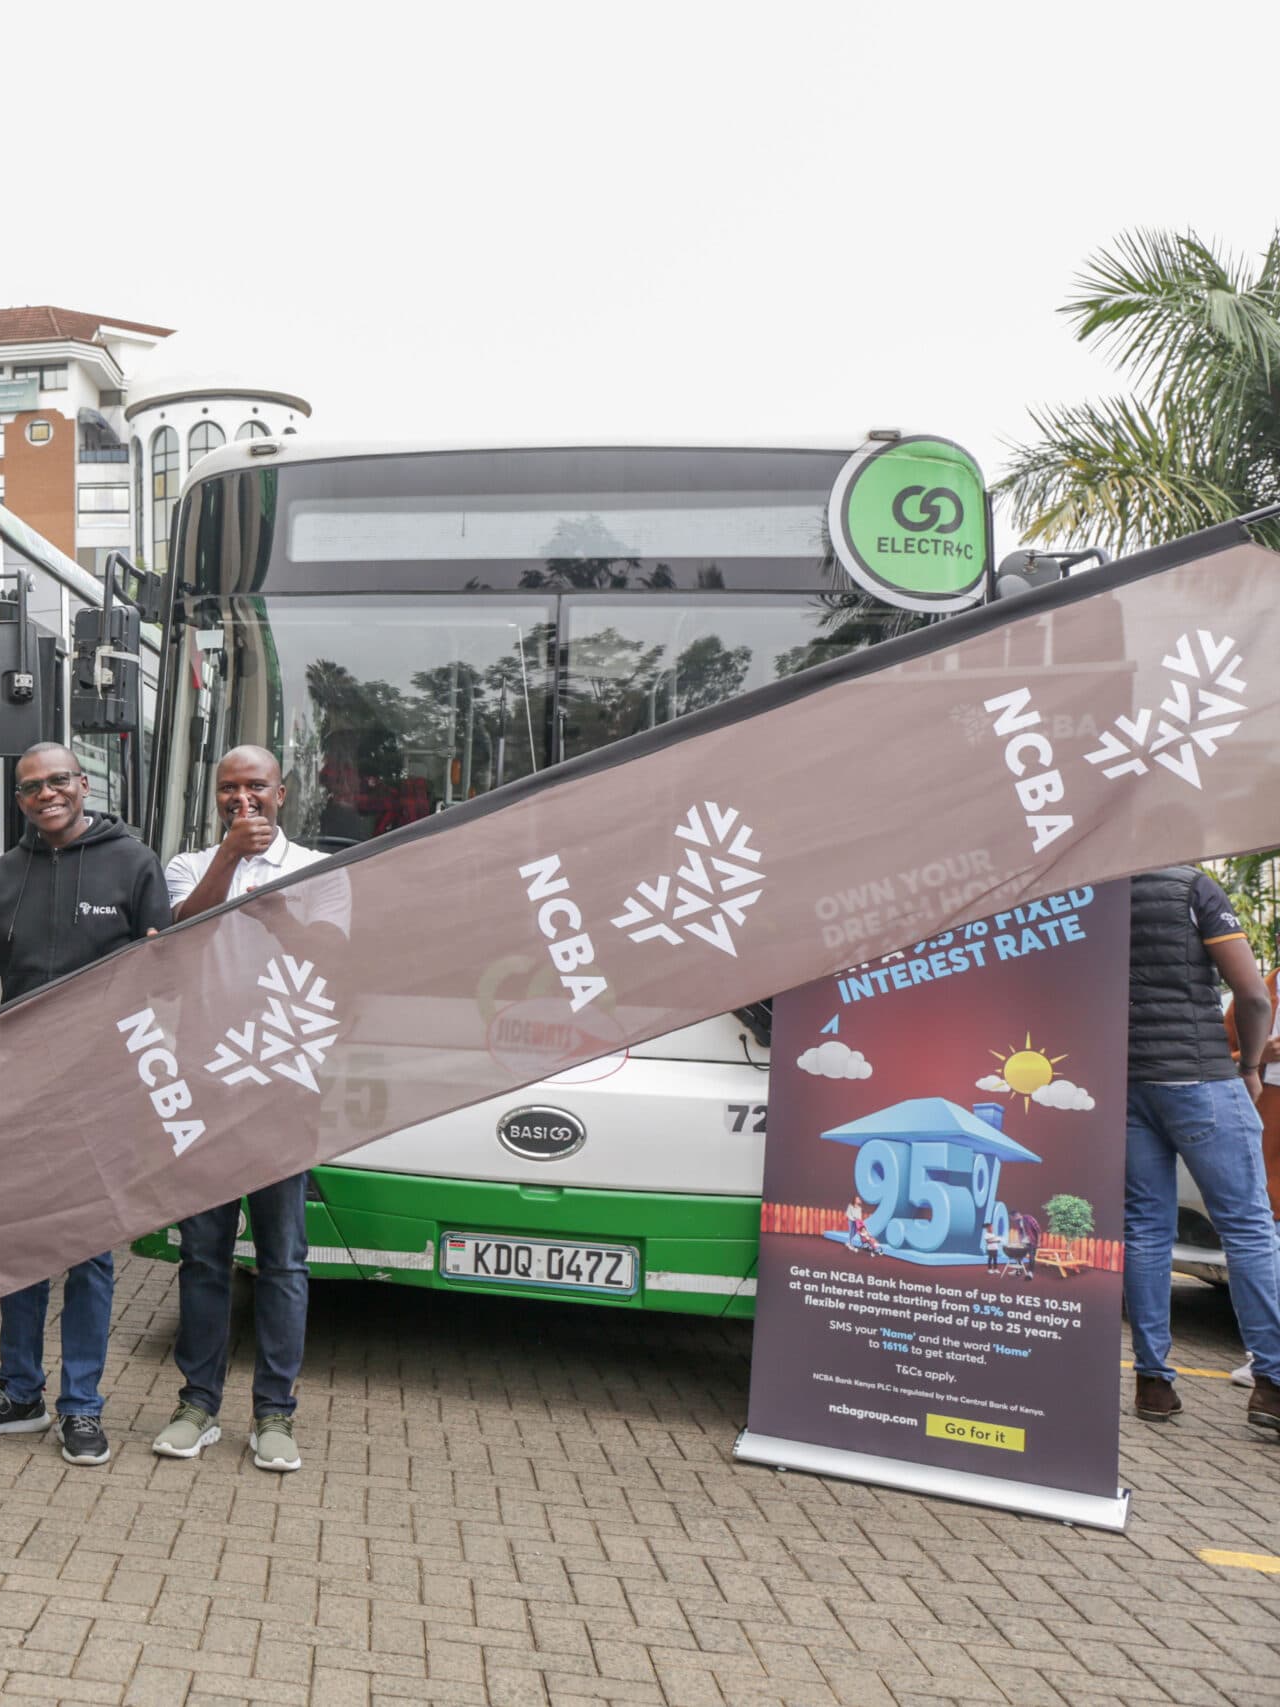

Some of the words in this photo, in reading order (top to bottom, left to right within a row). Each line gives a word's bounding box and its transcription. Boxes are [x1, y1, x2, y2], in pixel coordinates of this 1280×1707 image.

[983, 687, 1074, 854] NCBA
[815, 872, 896, 920] OWN
[898, 849, 994, 896] YOUR
[92, 905, 118, 915] NCBA
[519, 854, 609, 1013] NCBA
[837, 940, 987, 1004] INTEREST
[993, 914, 1087, 961] RATE
[115, 1007, 206, 1157] NCBA
[473, 1242, 532, 1278] KDQ
[546, 1247, 623, 1285] 047Z
[789, 1280, 802, 1290] at
[804, 1283, 818, 1292] an
[821, 1284, 864, 1299] Interest
[867, 1291, 890, 1302] rate
[893, 1294, 938, 1310] starting
[941, 1300, 970, 1312] from
[972, 1304, 1004, 1318] 9.5%
[1007, 1310, 1032, 1320] and
[1034, 1314, 1069, 1328] enjoy
[1072, 1320, 1081, 1328] a
[790, 1266, 810, 1278] Get
[813, 1270, 828, 1280] an
[830, 1270, 864, 1284] NCBA
[867, 1276, 896, 1288] Bank
[899, 1279, 932, 1293] home
[936, 1284, 962, 1298] loan
[965, 1289, 978, 1299] of
[981, 1292, 997, 1303] up
[1000, 1294, 1013, 1304] to
[1016, 1294, 1040, 1308] KES
[1044, 1299, 1082, 1312] 10.5M
[804, 1295, 846, 1310] flexible
[848, 1302, 912, 1319] repayment
[914, 1311, 952, 1324] period
[956, 1316, 969, 1326] of
[972, 1320, 987, 1331] up
[990, 1321, 1004, 1332] to
[1006, 1322, 1021, 1334] 25
[1024, 1326, 1062, 1340] years.
[829, 1320, 852, 1332] SMS
[855, 1326, 878, 1336] your
[918, 1334, 940, 1344] and
[942, 1336, 960, 1348] the
[962, 1341, 990, 1352] word
[868, 1340, 880, 1349] to
[882, 1341, 908, 1353] 16116
[911, 1345, 922, 1355] to
[924, 1350, 943, 1358] get
[945, 1350, 987, 1364] started.
[896, 1364, 922, 1377] T&Cs
[924, 1370, 957, 1383] apply.
[812, 1373, 834, 1382] NCBA
[835, 1376, 852, 1385] Bank
[877, 1383, 892, 1392] PLC
[946, 1394, 958, 1402] the
[960, 1396, 988, 1406] Central
[989, 1401, 1008, 1410] Bank
[1010, 1404, 1018, 1412] of
[828, 1404, 918, 1426] ncbagroup.com
[944, 1422, 966, 1436] Go
[970, 1426, 991, 1440] for
[995, 1430, 1006, 1443] it
